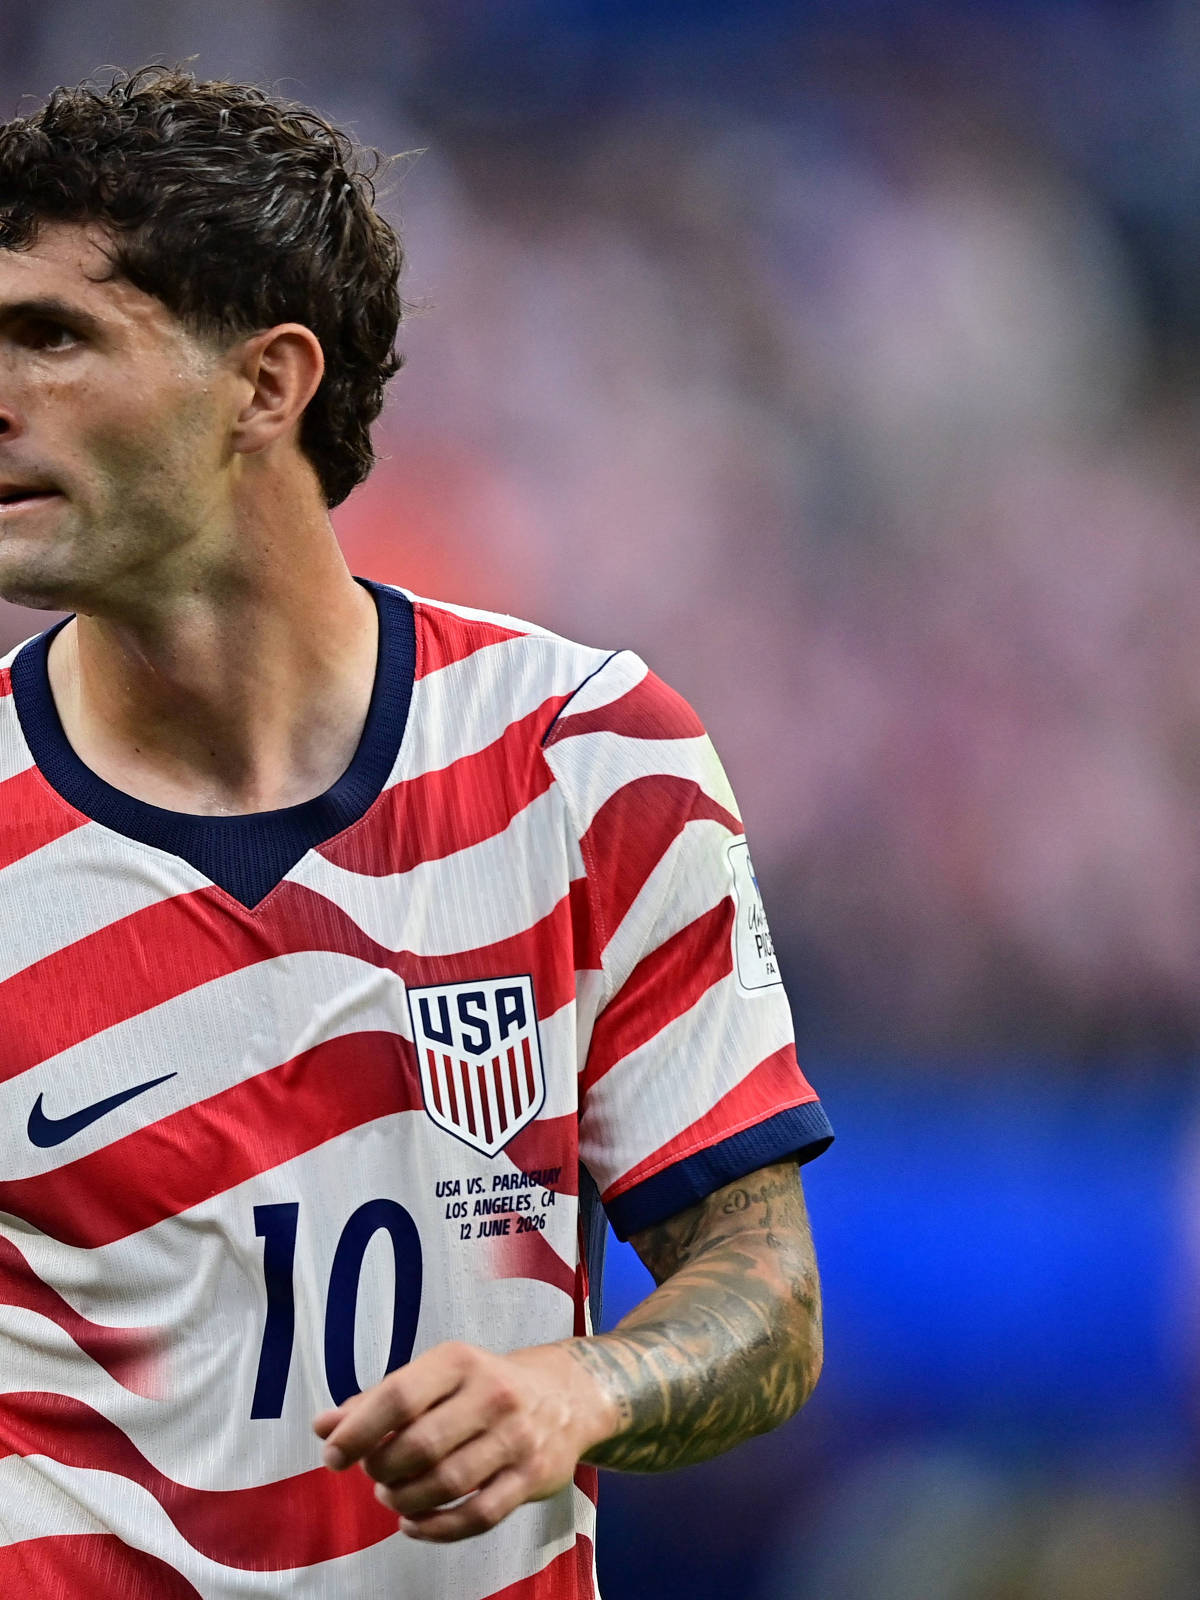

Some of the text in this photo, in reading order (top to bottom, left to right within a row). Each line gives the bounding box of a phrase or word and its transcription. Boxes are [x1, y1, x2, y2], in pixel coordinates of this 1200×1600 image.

[418, 986, 527, 1055] USA
[435, 1166, 562, 1198] USA VS. PARAGUAY
[445, 1190, 556, 1219] LOS ANGELES, CA
[460, 1213, 547, 1240] 12 JUNE 2026
[250, 1198, 423, 1419] 10
